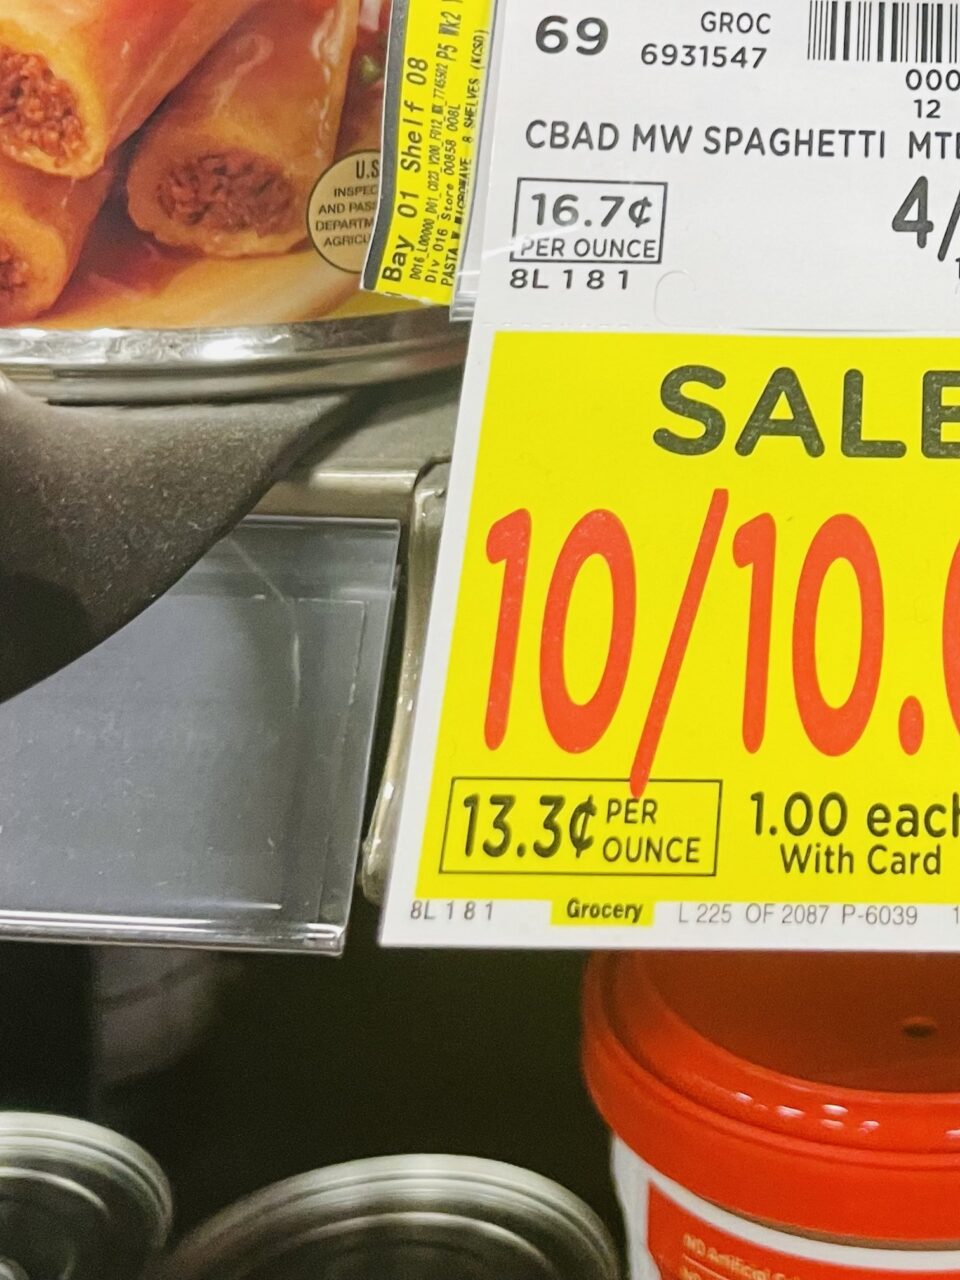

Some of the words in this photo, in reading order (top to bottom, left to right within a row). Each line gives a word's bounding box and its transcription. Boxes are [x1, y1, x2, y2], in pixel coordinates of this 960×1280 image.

[535, 15, 609, 55] 69
[700, 11, 771, 35] GROC
[436, 43, 458, 61] P5
[640, 44, 767, 69] 6931547
[406, 57, 428, 85] 08
[913, 98, 940, 119] 12
[400, 100, 424, 173] Shelf
[525, 119, 620, 150] CBAD
[632, 122, 692, 153] MW
[703, 126, 885, 158] SPAGHETTI
[319, 202, 345, 215] AND
[397, 190, 419, 218] 01
[441, 183, 454, 221] Store
[531, 192, 653, 228] 16.7¢
[432, 229, 448, 251] 016
[520, 237, 564, 258] PER
[574, 239, 657, 260] OUNCE
[382, 235, 415, 282] Bay
[425, 259, 440, 284] Div
[441, 248, 460, 286] PASTA
[464, 793, 598, 858] 13.3¢
[606, 798, 658, 824] PER
[750, 791, 848, 837] 1.00
[602, 836, 700, 864] OUNCE
[779, 842, 854, 875] With
[867, 844, 942, 876] Card
[566, 898, 643, 923] Grocery
[696, 904, 732, 924] 225
[745, 904, 774, 924] OF
[782, 905, 829, 925] 2087
[841, 904, 918, 925] P-6039
